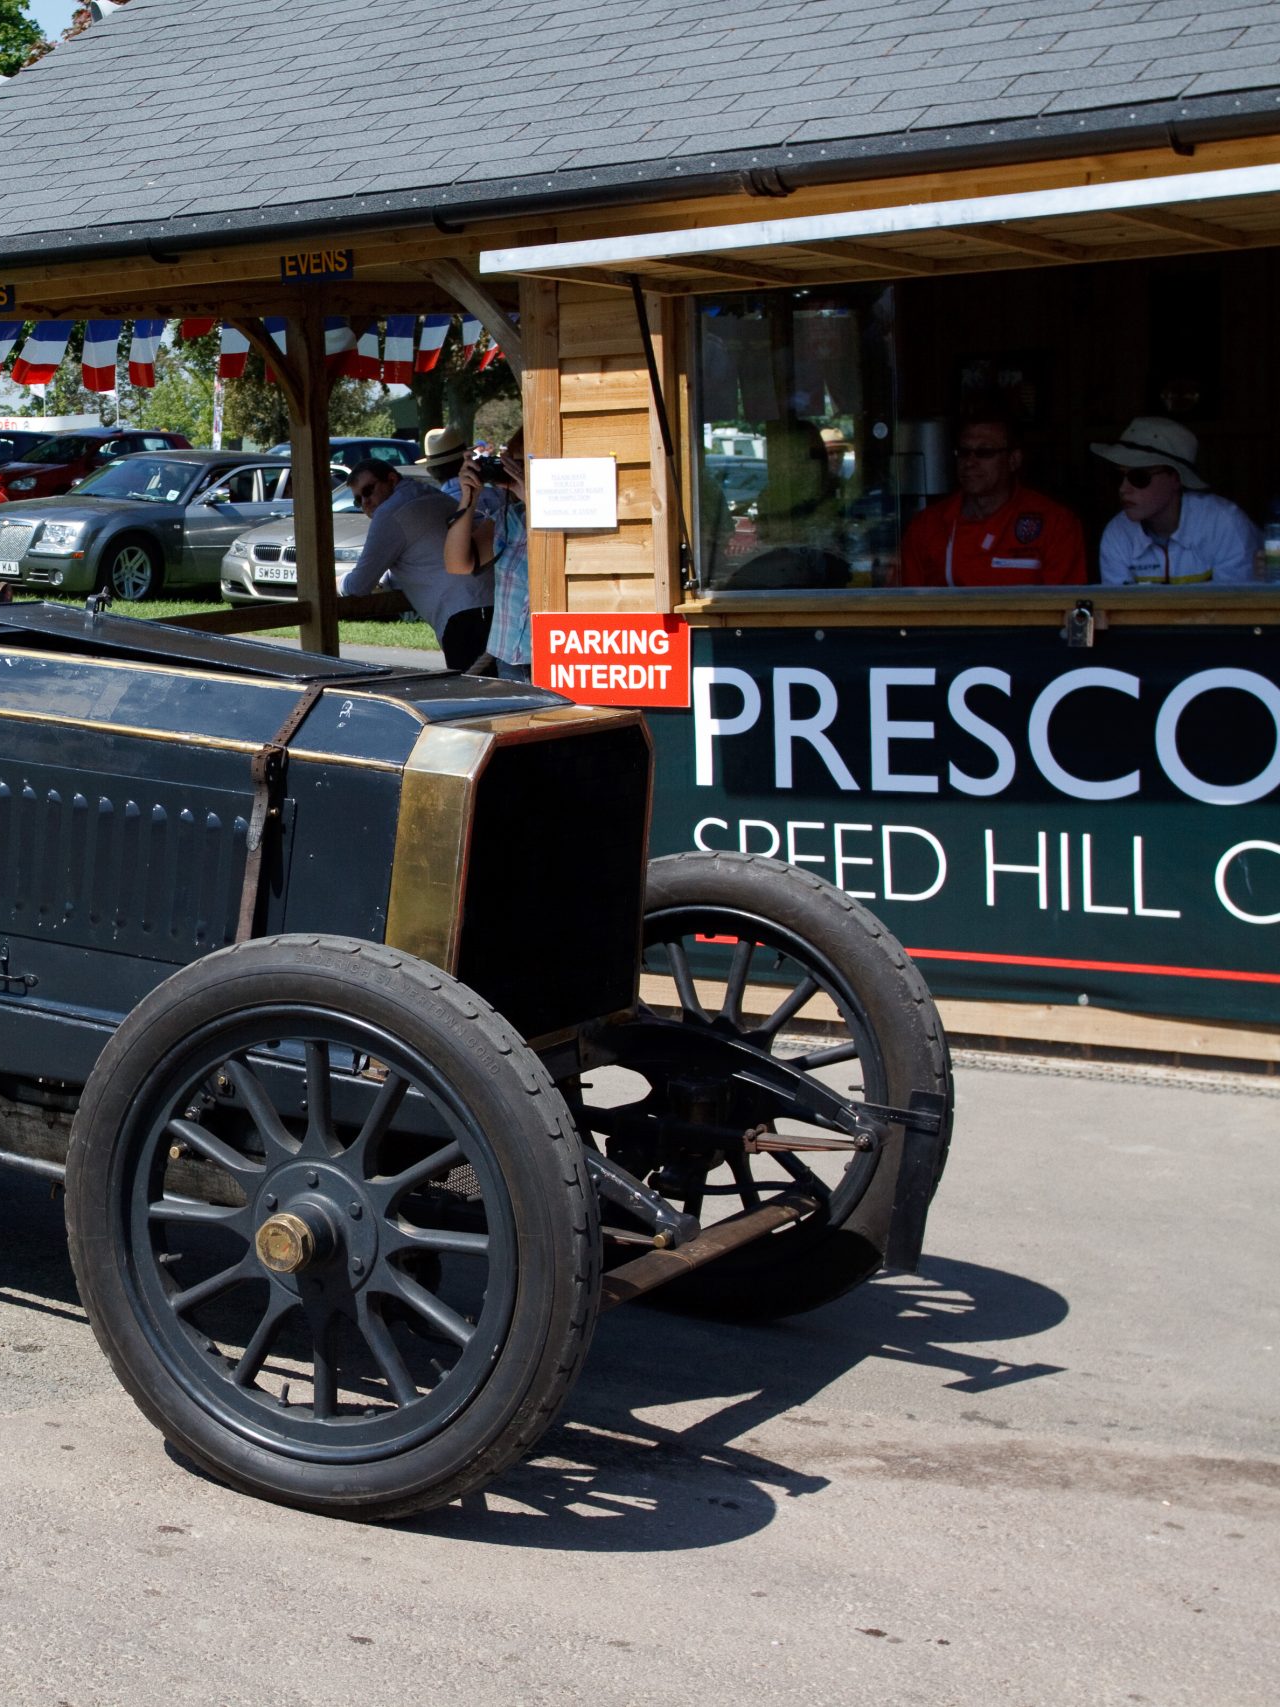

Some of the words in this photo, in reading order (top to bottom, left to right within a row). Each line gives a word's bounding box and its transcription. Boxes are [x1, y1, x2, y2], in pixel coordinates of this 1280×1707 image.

[285, 250, 347, 276] EVENS
[259, 567, 281, 579] SW59
[283, 569, 295, 580] BY
[550, 630, 669, 655] PARKING
[550, 664, 672, 690] INTERDIT
[692, 667, 1280, 806] PRESCO
[985, 828, 1181, 918] HILL
